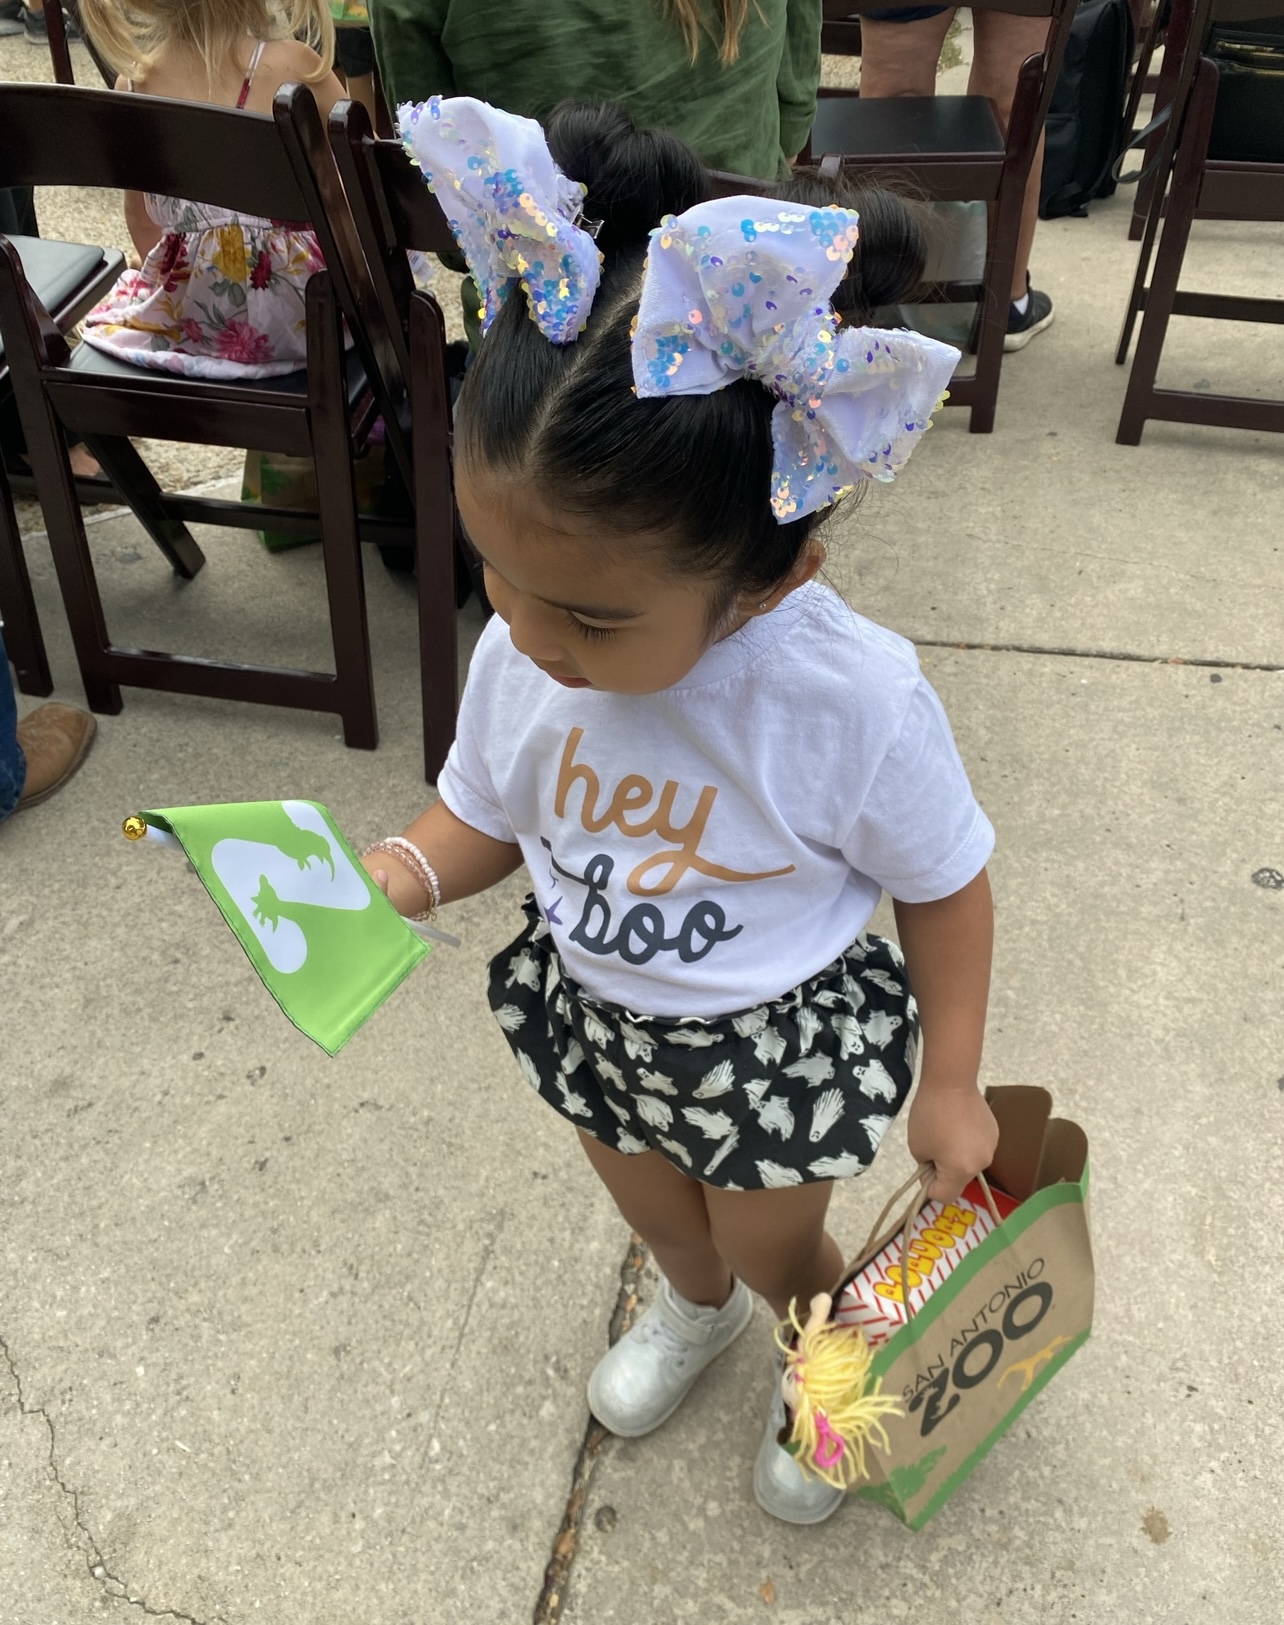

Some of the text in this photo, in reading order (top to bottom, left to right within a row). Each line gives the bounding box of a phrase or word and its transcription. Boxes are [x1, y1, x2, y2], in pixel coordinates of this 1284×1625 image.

[554, 727, 796, 897] hey
[540, 836, 744, 965] boo
[903, 1257, 1045, 1404] SAN ANTONIO
[908, 1281, 1054, 1438] ZOO
